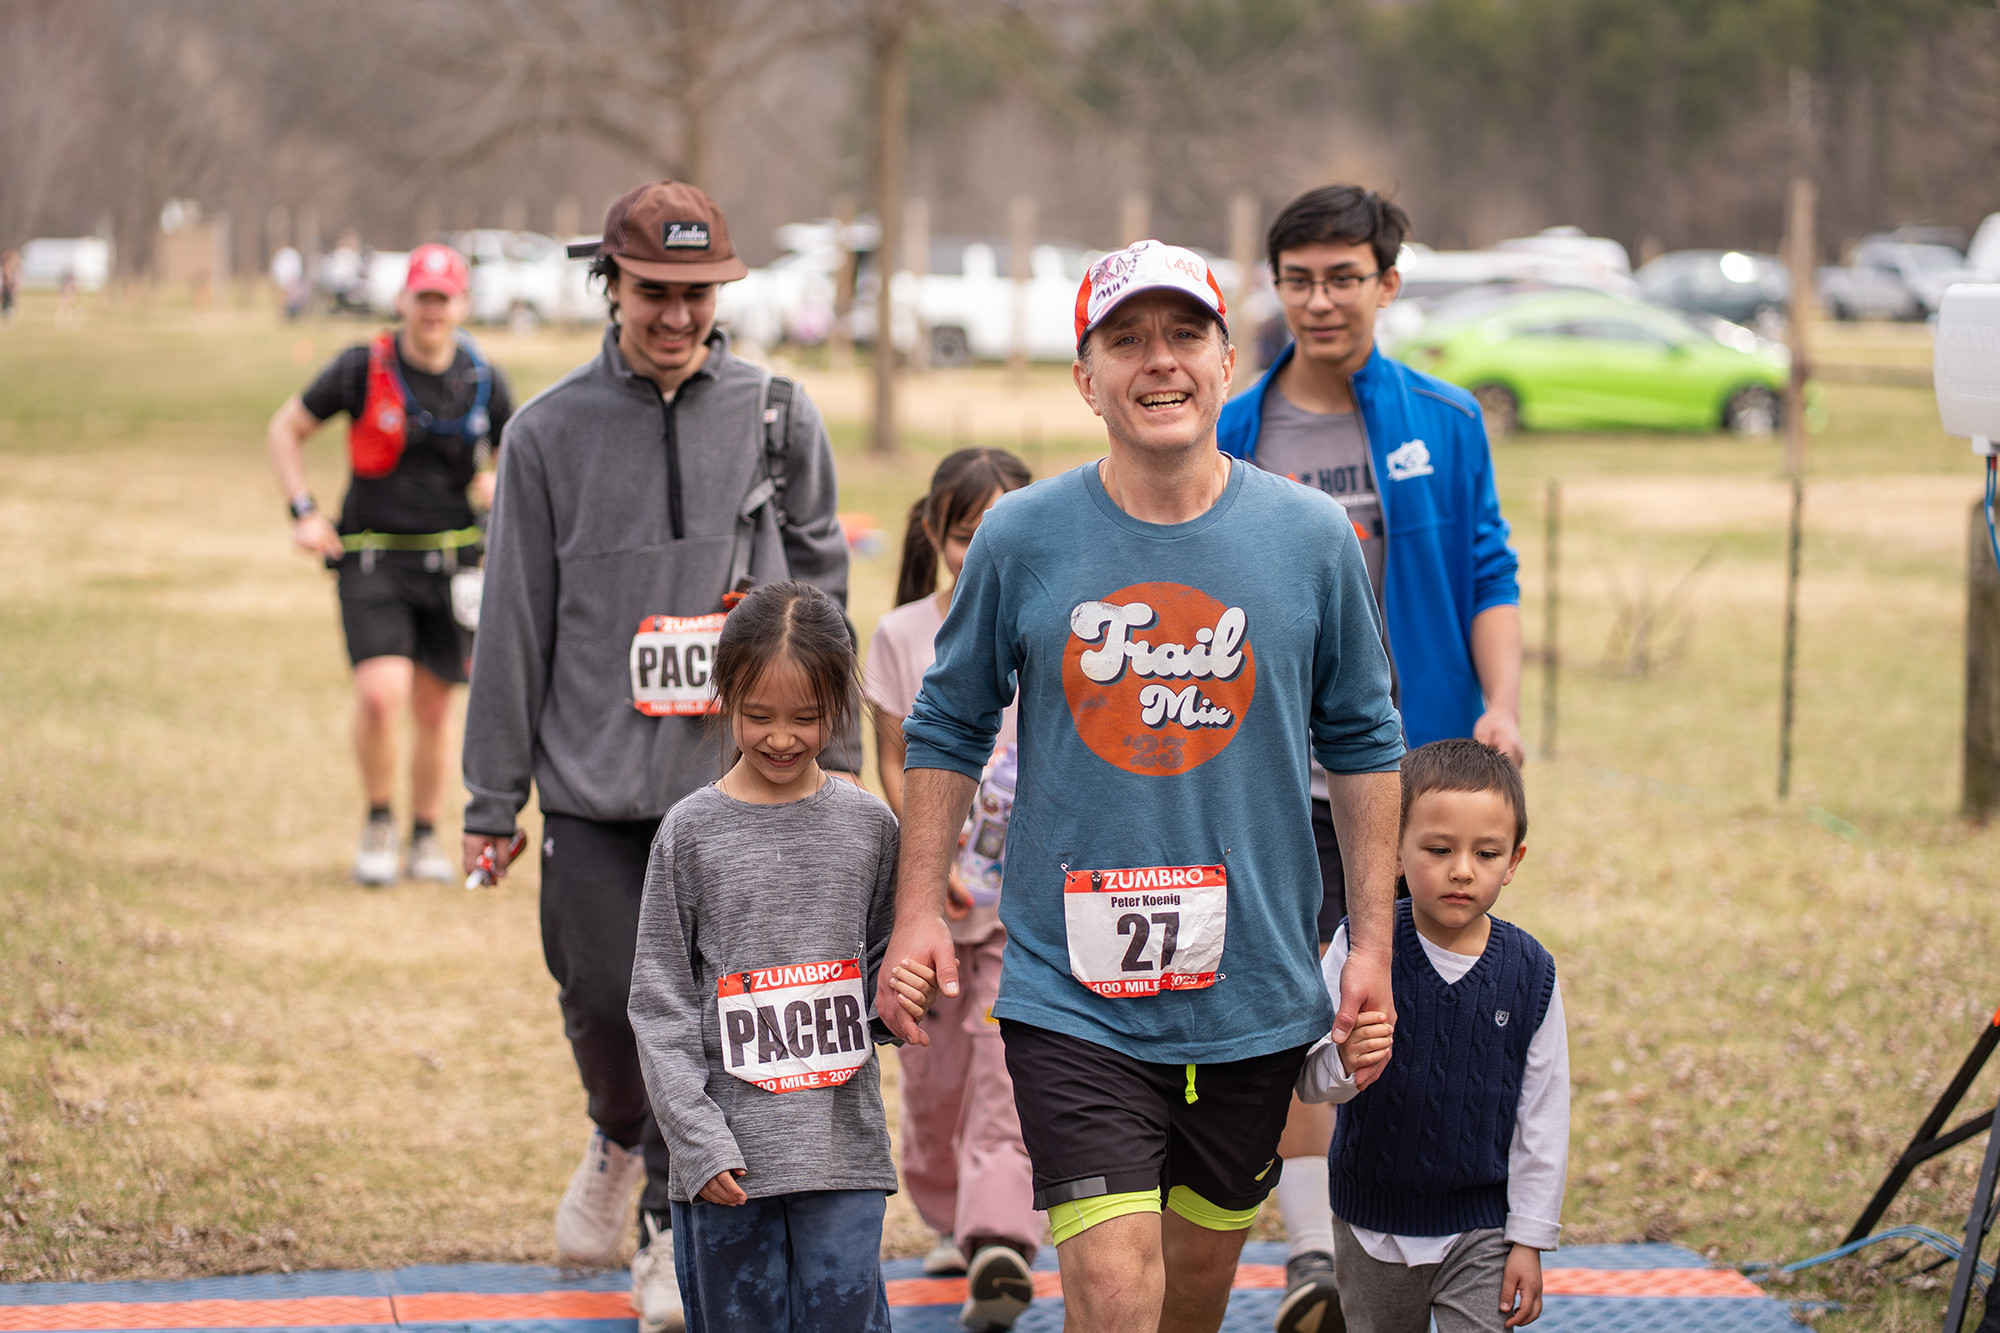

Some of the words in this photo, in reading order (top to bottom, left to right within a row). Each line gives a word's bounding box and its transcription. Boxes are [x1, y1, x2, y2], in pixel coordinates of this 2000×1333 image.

[1317, 465, 1357, 493] HOT
[1070, 601, 1248, 683] Trail
[638, 645, 718, 688] PAC
[1139, 684, 1234, 728] Mix
[1104, 869, 1204, 890] ZUMBRO
[1111, 895, 1140, 908] Peter
[1142, 893, 1181, 907] Koenig
[1117, 912, 1179, 972] 27
[753, 963, 842, 989] ZUMBRO
[1093, 982, 1121, 994] 100
[1125, 980, 1160, 993] MILE
[726, 995, 865, 1068] PACER
[753, 1080, 776, 1092] 00
[781, 1073, 820, 1089] MILE
